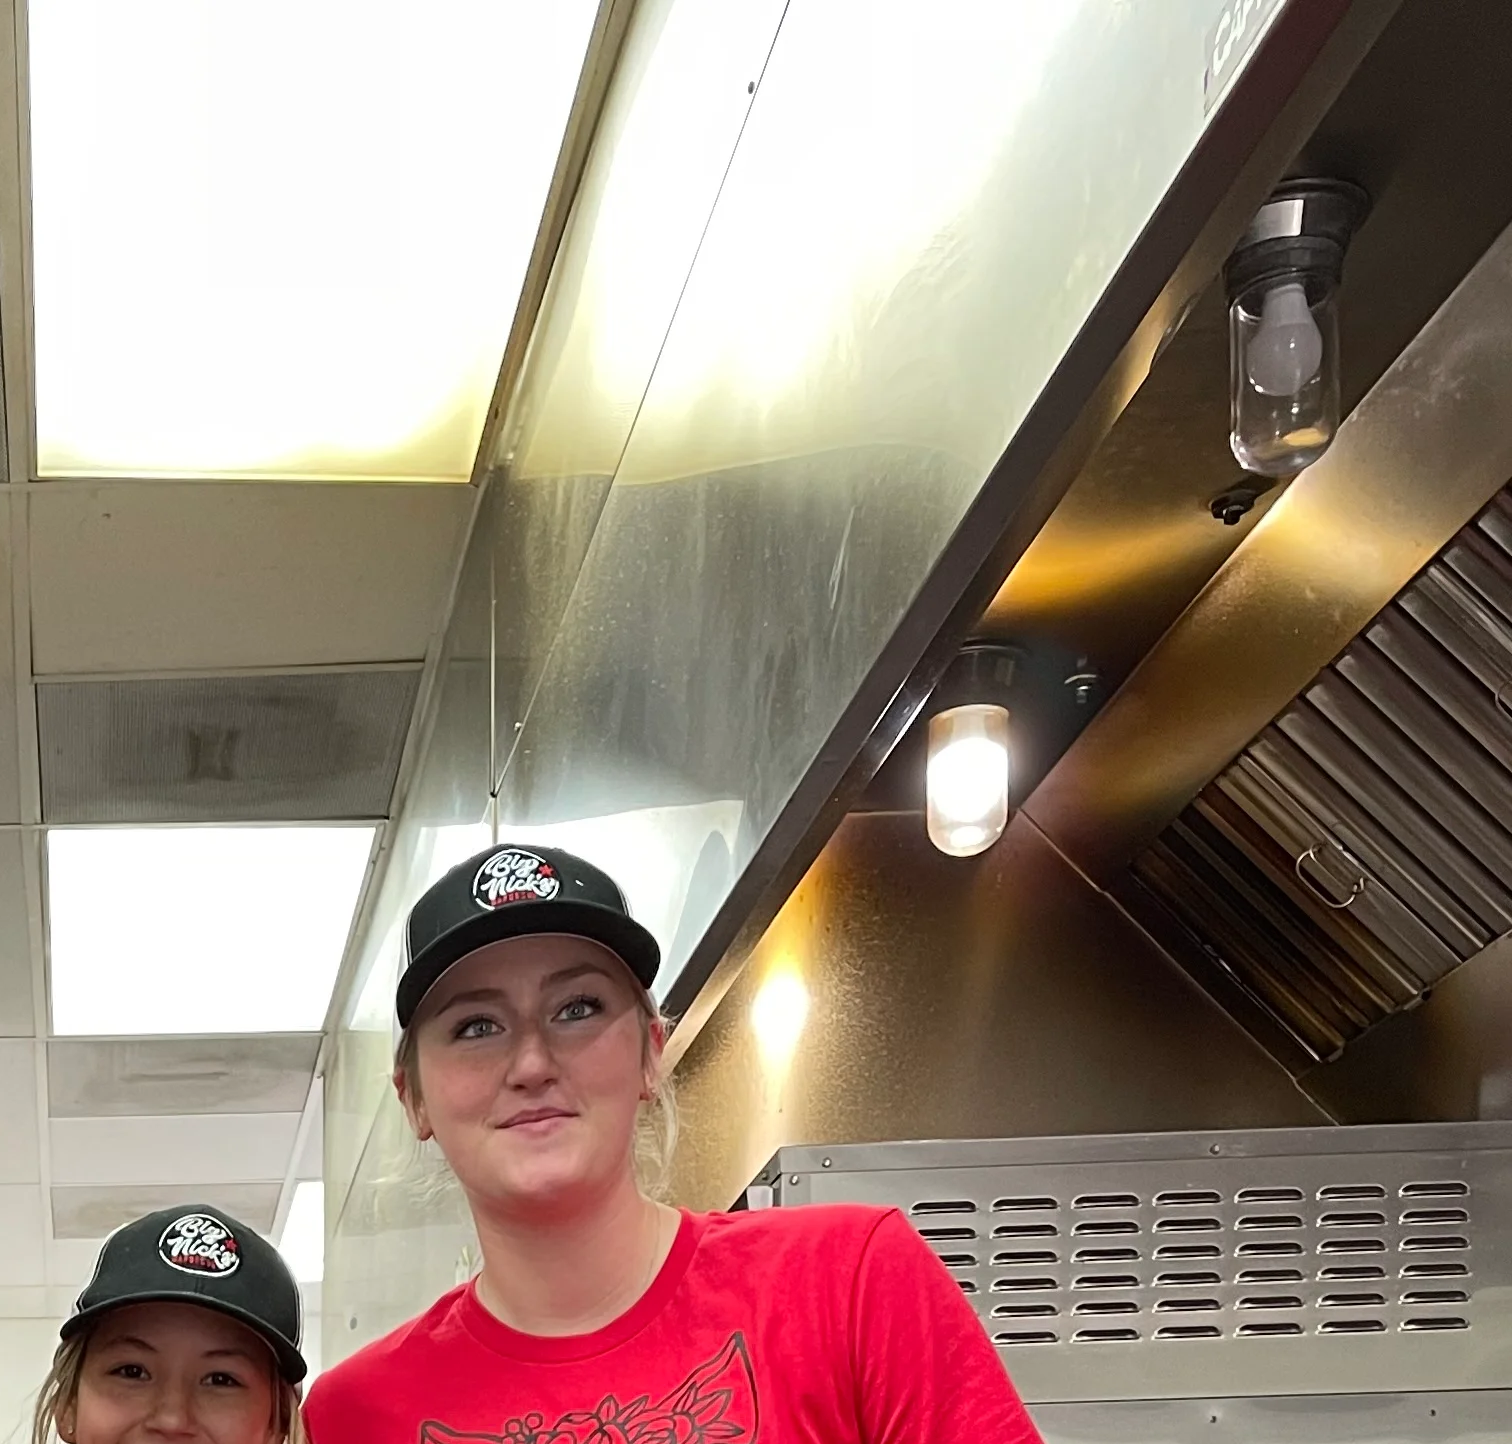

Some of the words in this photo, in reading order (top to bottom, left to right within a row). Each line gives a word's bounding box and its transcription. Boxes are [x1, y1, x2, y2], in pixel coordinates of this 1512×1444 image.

[485, 854, 539, 878] Big
[480, 873, 556, 900] Nick's
[175, 1217, 227, 1245] Big
[167, 1236, 237, 1270] Nick's
